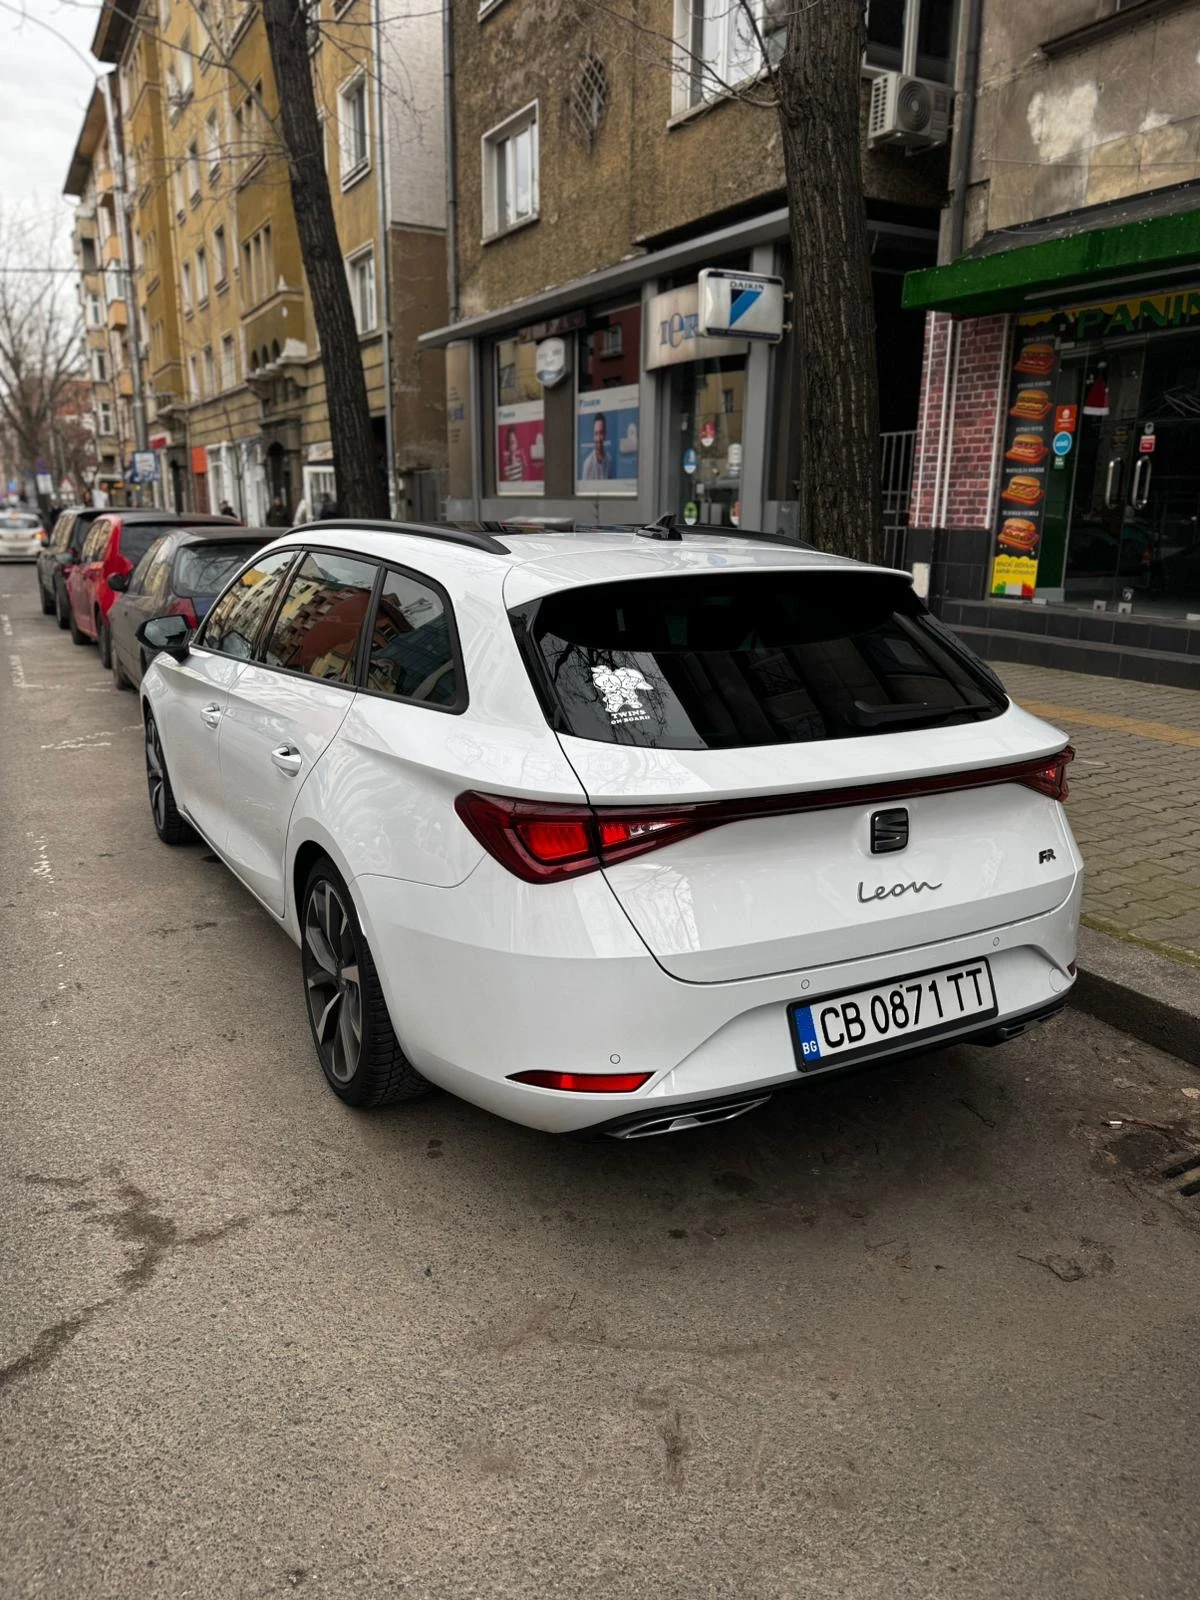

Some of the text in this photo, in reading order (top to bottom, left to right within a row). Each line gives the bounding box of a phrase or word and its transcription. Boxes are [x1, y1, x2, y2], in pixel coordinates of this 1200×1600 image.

[729, 281, 765, 290] DAIKIN
[611, 710, 646, 719] TWINS
[1038, 848, 1056, 865] FR
[857, 880, 943, 903] Leon
[820, 968, 983, 1047] CB 0871 TT
[802, 1040, 817, 1055] BG
